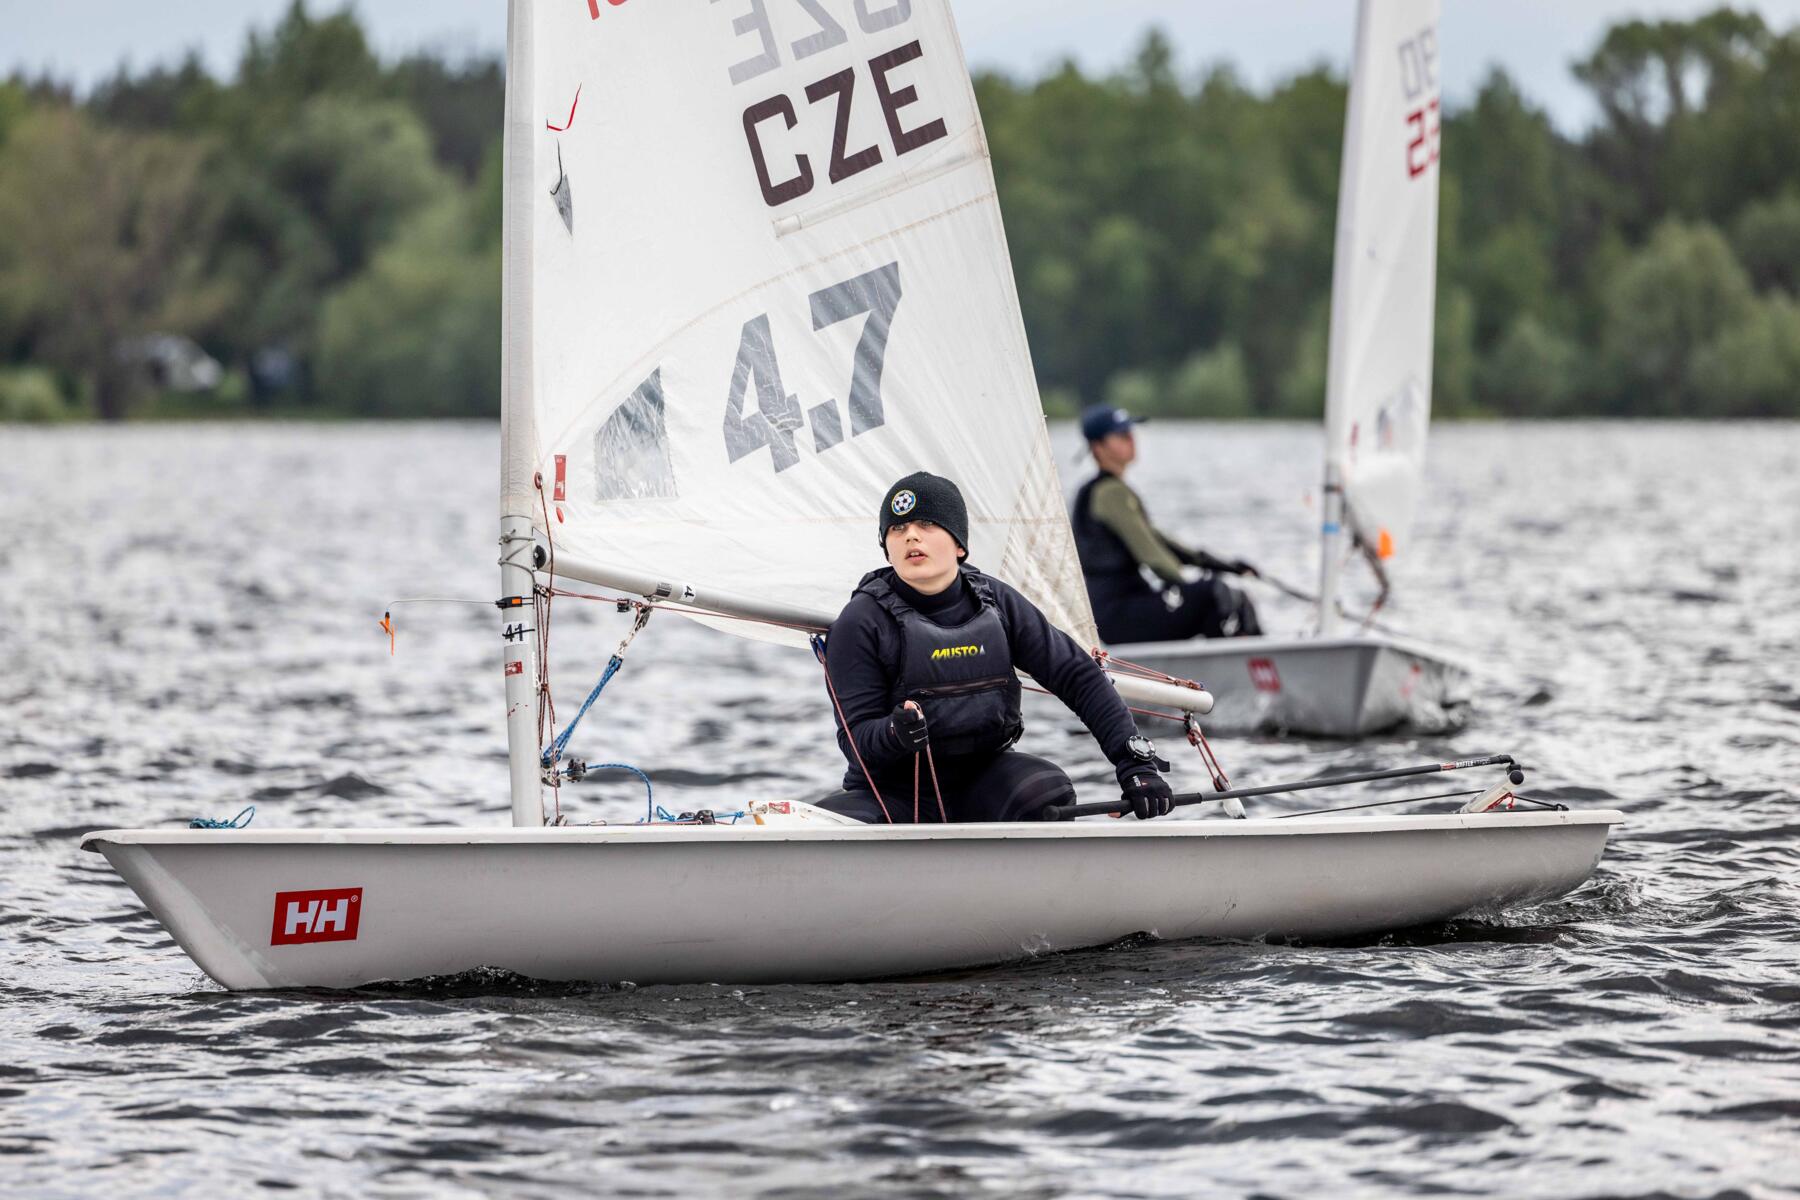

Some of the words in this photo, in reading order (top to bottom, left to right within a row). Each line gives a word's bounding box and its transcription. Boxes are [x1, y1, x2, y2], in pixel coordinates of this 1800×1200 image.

[742, 39, 948, 207] CZE
[723, 261, 902, 474] 4.7
[931, 645, 978, 660] MUSTO
